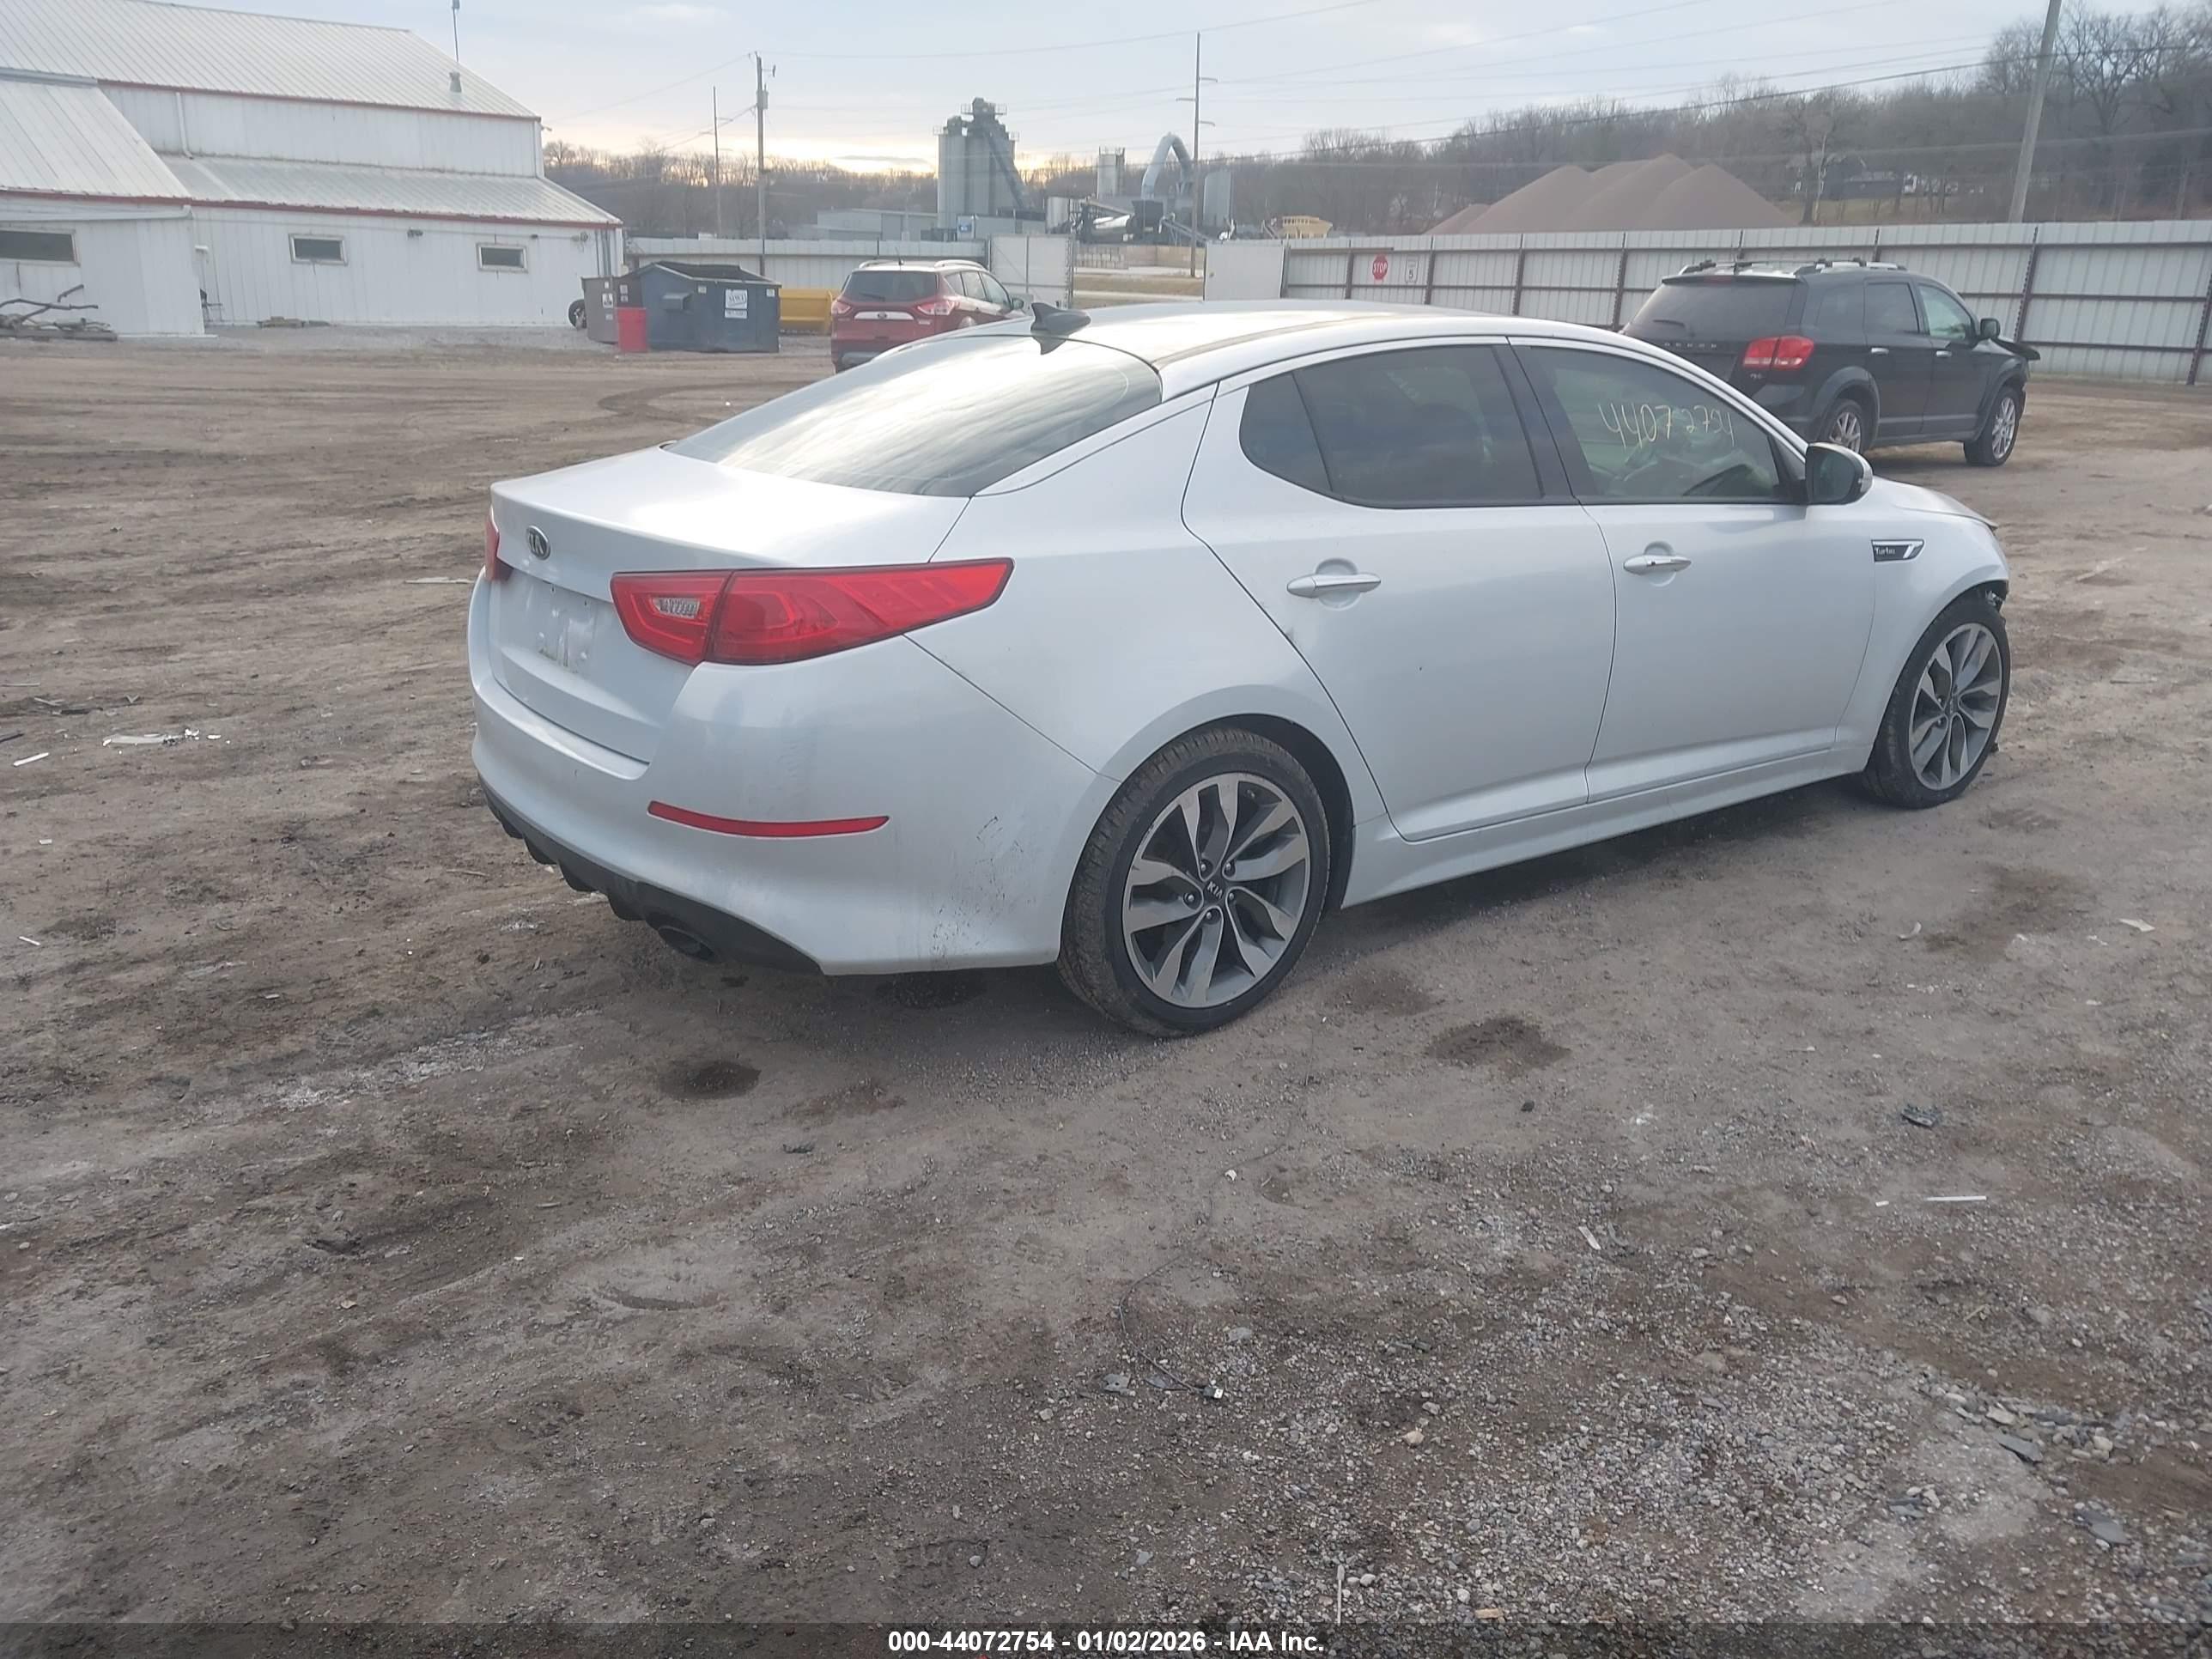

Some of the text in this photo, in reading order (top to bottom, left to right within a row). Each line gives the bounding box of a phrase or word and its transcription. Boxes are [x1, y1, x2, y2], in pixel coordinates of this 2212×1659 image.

[1373, 261, 1388, 273] STOP
[1875, 545, 1896, 556] Turbo
[1206, 881, 1224, 899] KIA
